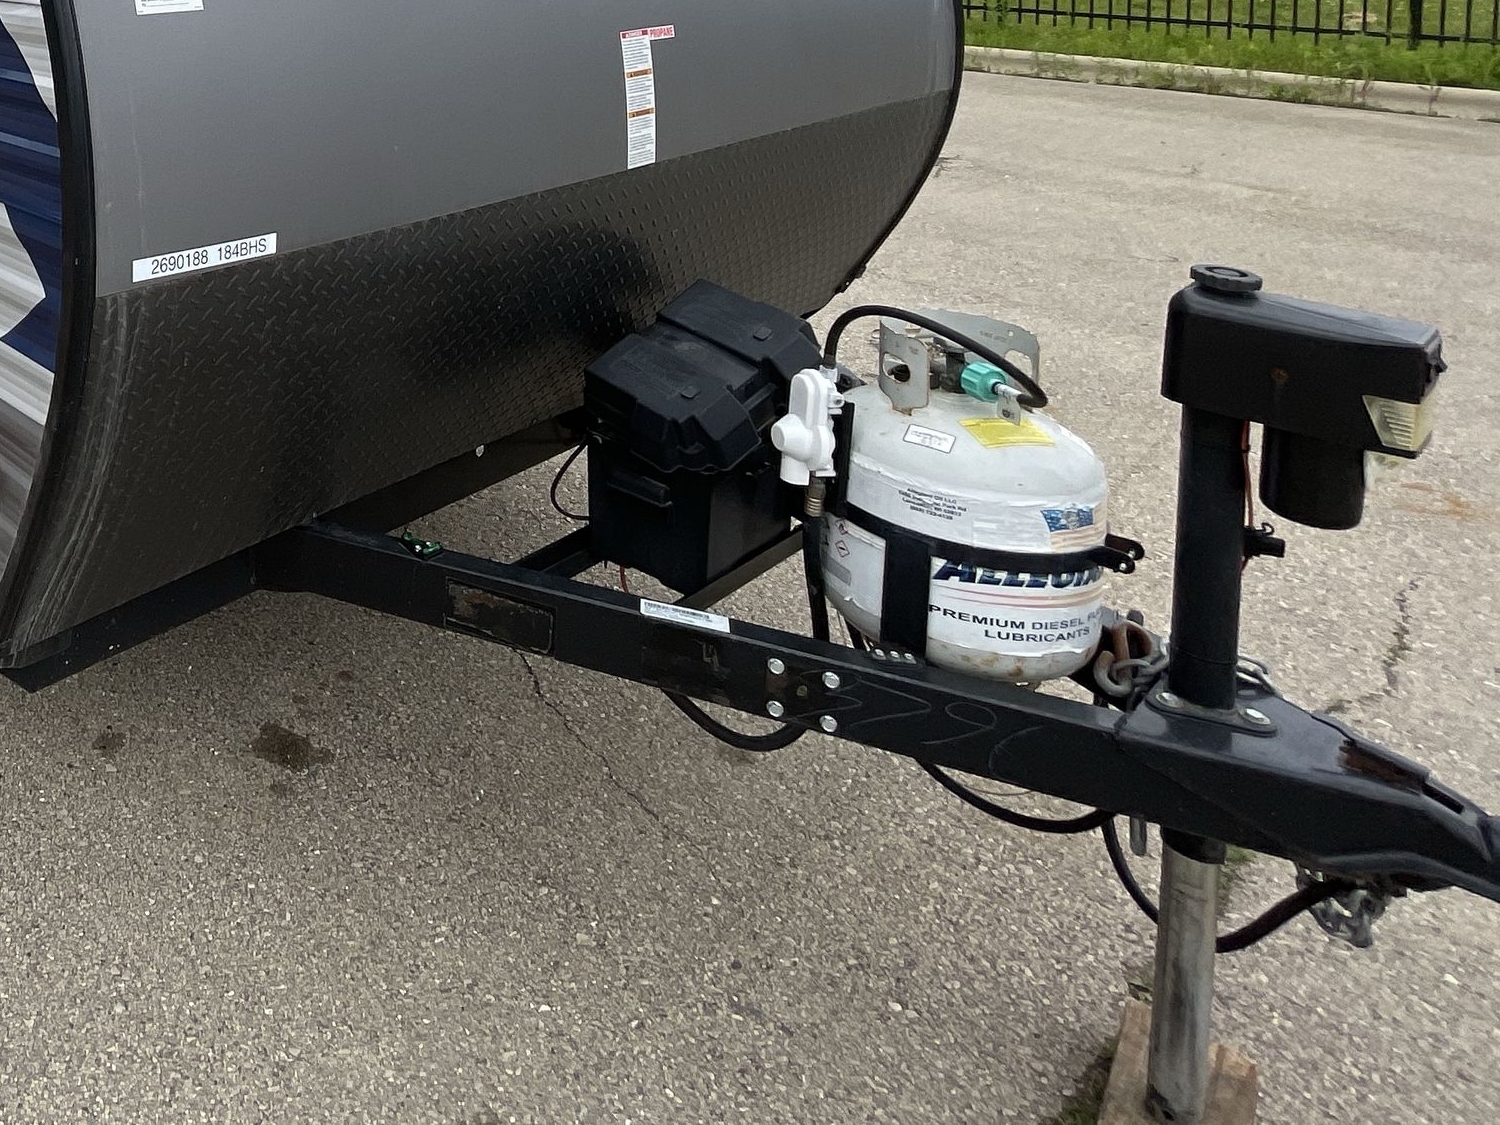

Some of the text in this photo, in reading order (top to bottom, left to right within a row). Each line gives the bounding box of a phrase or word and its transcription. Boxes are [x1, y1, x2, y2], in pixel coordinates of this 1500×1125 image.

[151, 238, 267, 275] 2690188 184BHS
[929, 604, 1025, 630] PREMIUM
[1032, 618, 1084, 631] DIESEL
[984, 627, 1090, 642] LUBRICANTS
